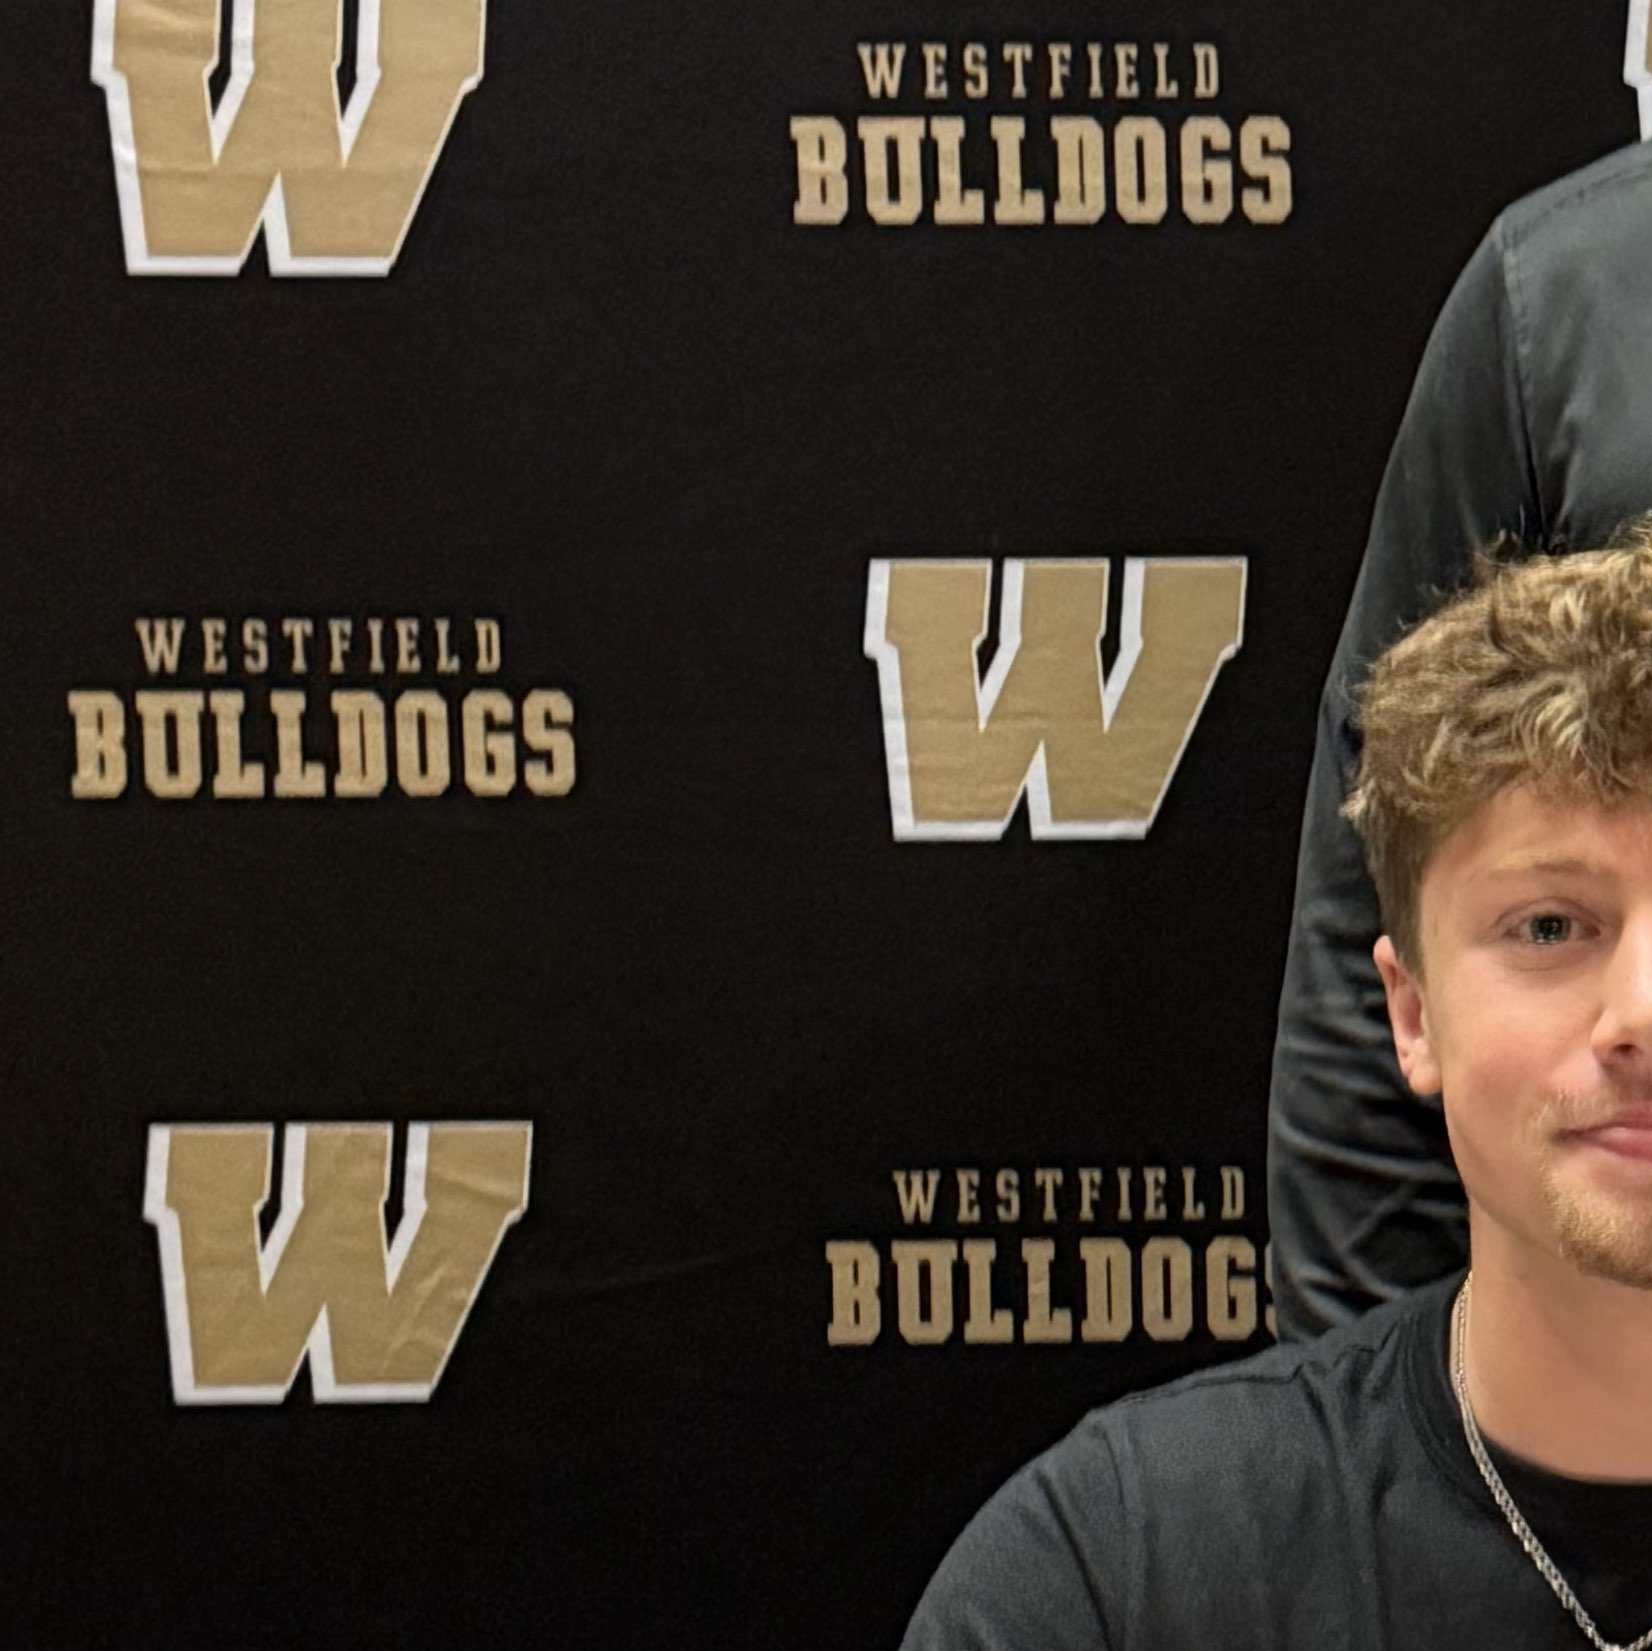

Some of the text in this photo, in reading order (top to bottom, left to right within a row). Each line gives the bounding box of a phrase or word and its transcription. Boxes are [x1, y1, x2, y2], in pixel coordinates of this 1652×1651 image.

[857, 43, 1219, 99] WESTFIELD
[90, 0, 487, 276] W
[790, 116, 1292, 225] BULLDOGS
[135, 618, 501, 674] WESTFIELD
[863, 557, 1248, 842] W
[67, 689, 576, 798] BULLDOGS
[893, 1166, 1247, 1223] WESTFIELD
[143, 1121, 534, 1404] W
